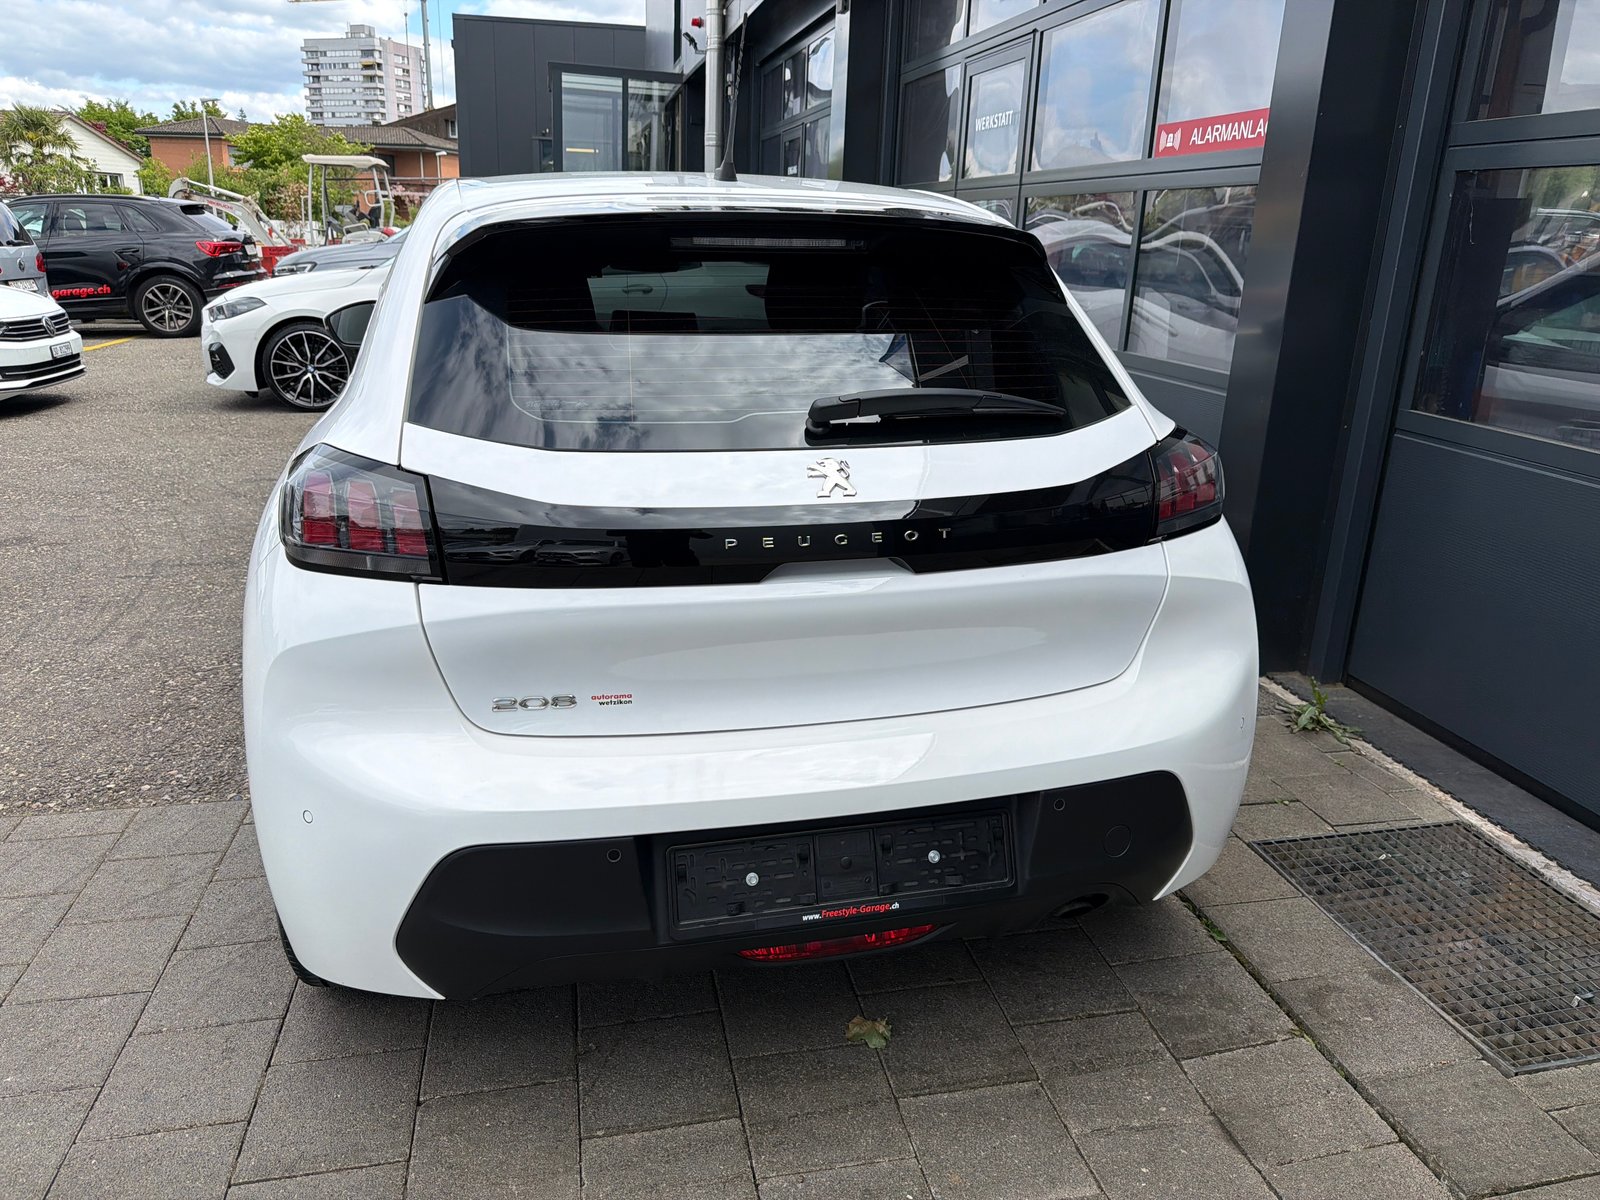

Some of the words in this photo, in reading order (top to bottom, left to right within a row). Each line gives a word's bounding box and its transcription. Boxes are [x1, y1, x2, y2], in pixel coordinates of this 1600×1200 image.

[975, 110, 1014, 132] WERKSTATT
[725, 527, 952, 550] PEUGEOT
[492, 693, 577, 712] 208
[591, 692, 633, 701] autorama
[802, 901, 900, 921] www.Freestyle-Garage.ch
